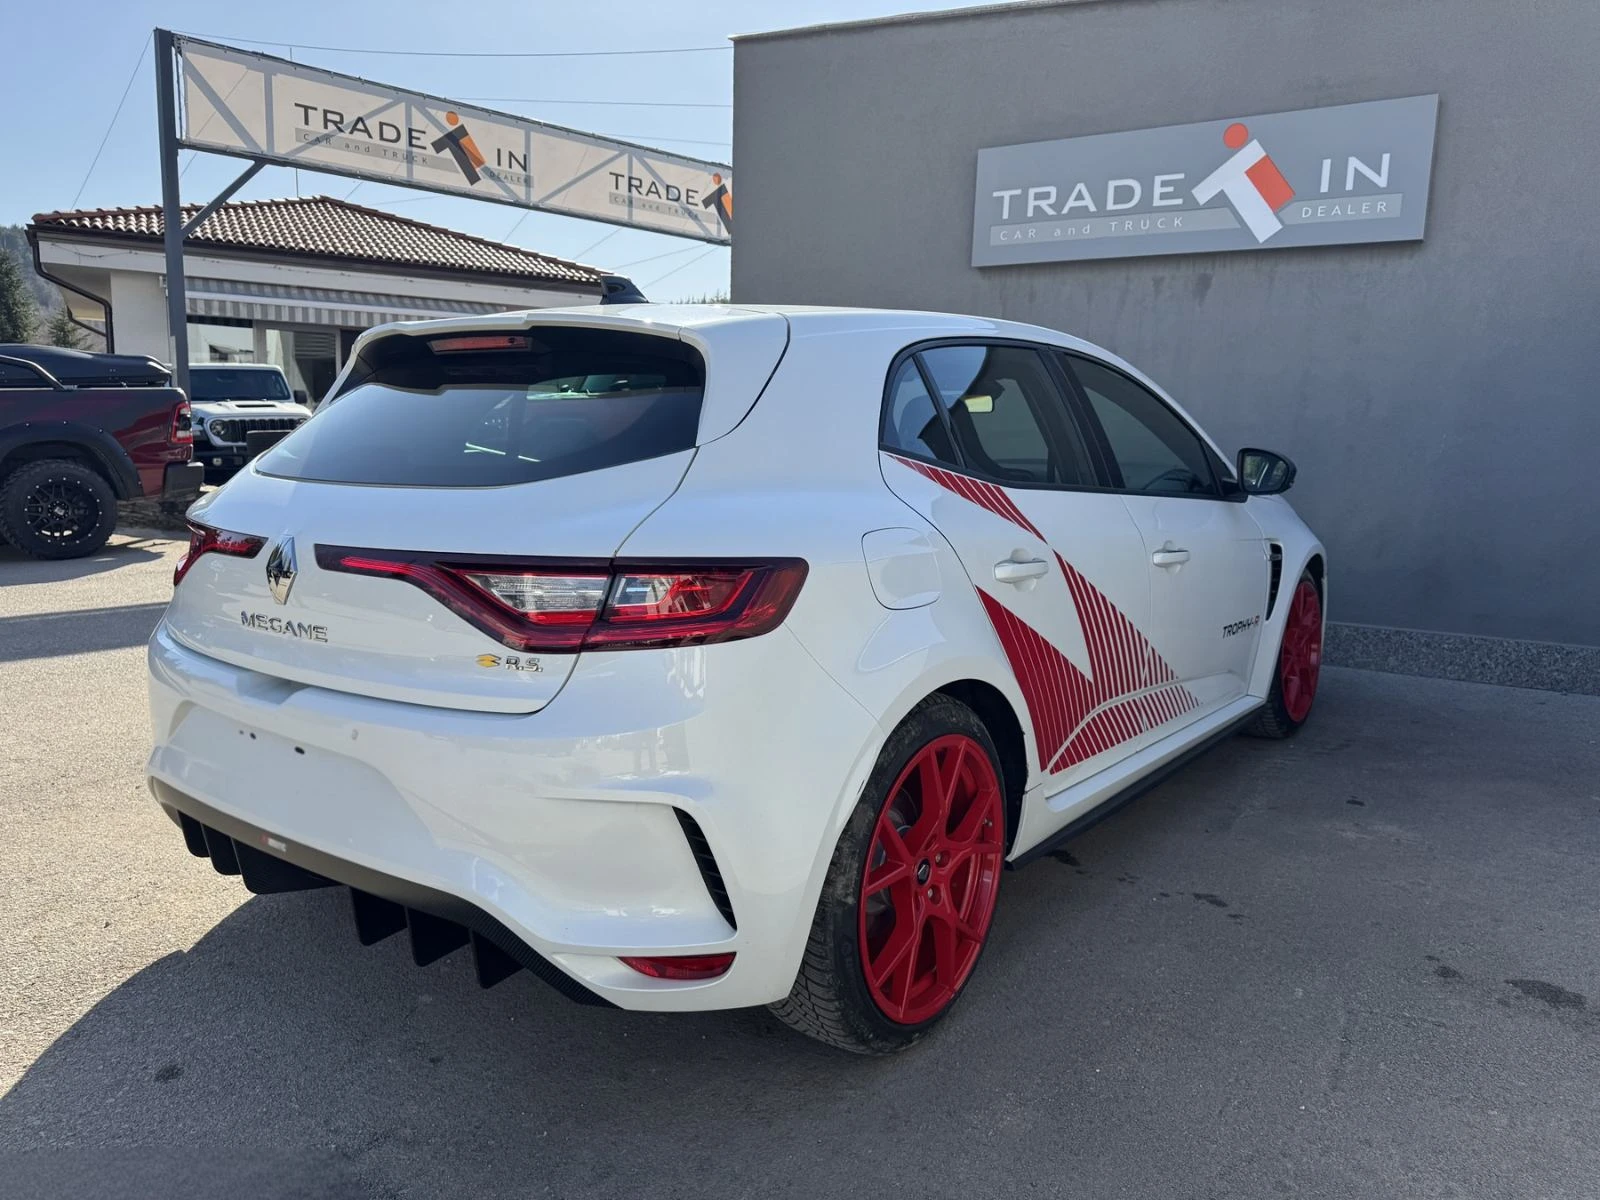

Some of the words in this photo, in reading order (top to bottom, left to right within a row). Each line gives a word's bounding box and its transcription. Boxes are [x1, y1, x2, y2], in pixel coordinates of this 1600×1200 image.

[293, 102, 427, 150] TRADE
[496, 147, 528, 172] IN
[303, 133, 333, 146] CAR
[344, 141, 371, 153] and
[382, 149, 428, 164] TRUCK
[609, 171, 699, 207] TRADE
[992, 172, 1186, 220] TRADE
[1319, 152, 1391, 193] IN
[1000, 227, 1037, 241] CAR
[1053, 223, 1091, 237] and
[1109, 216, 1184, 232] TRUCK
[1301, 201, 1387, 218] DEALER
[240, 610, 329, 643] MEGANE
